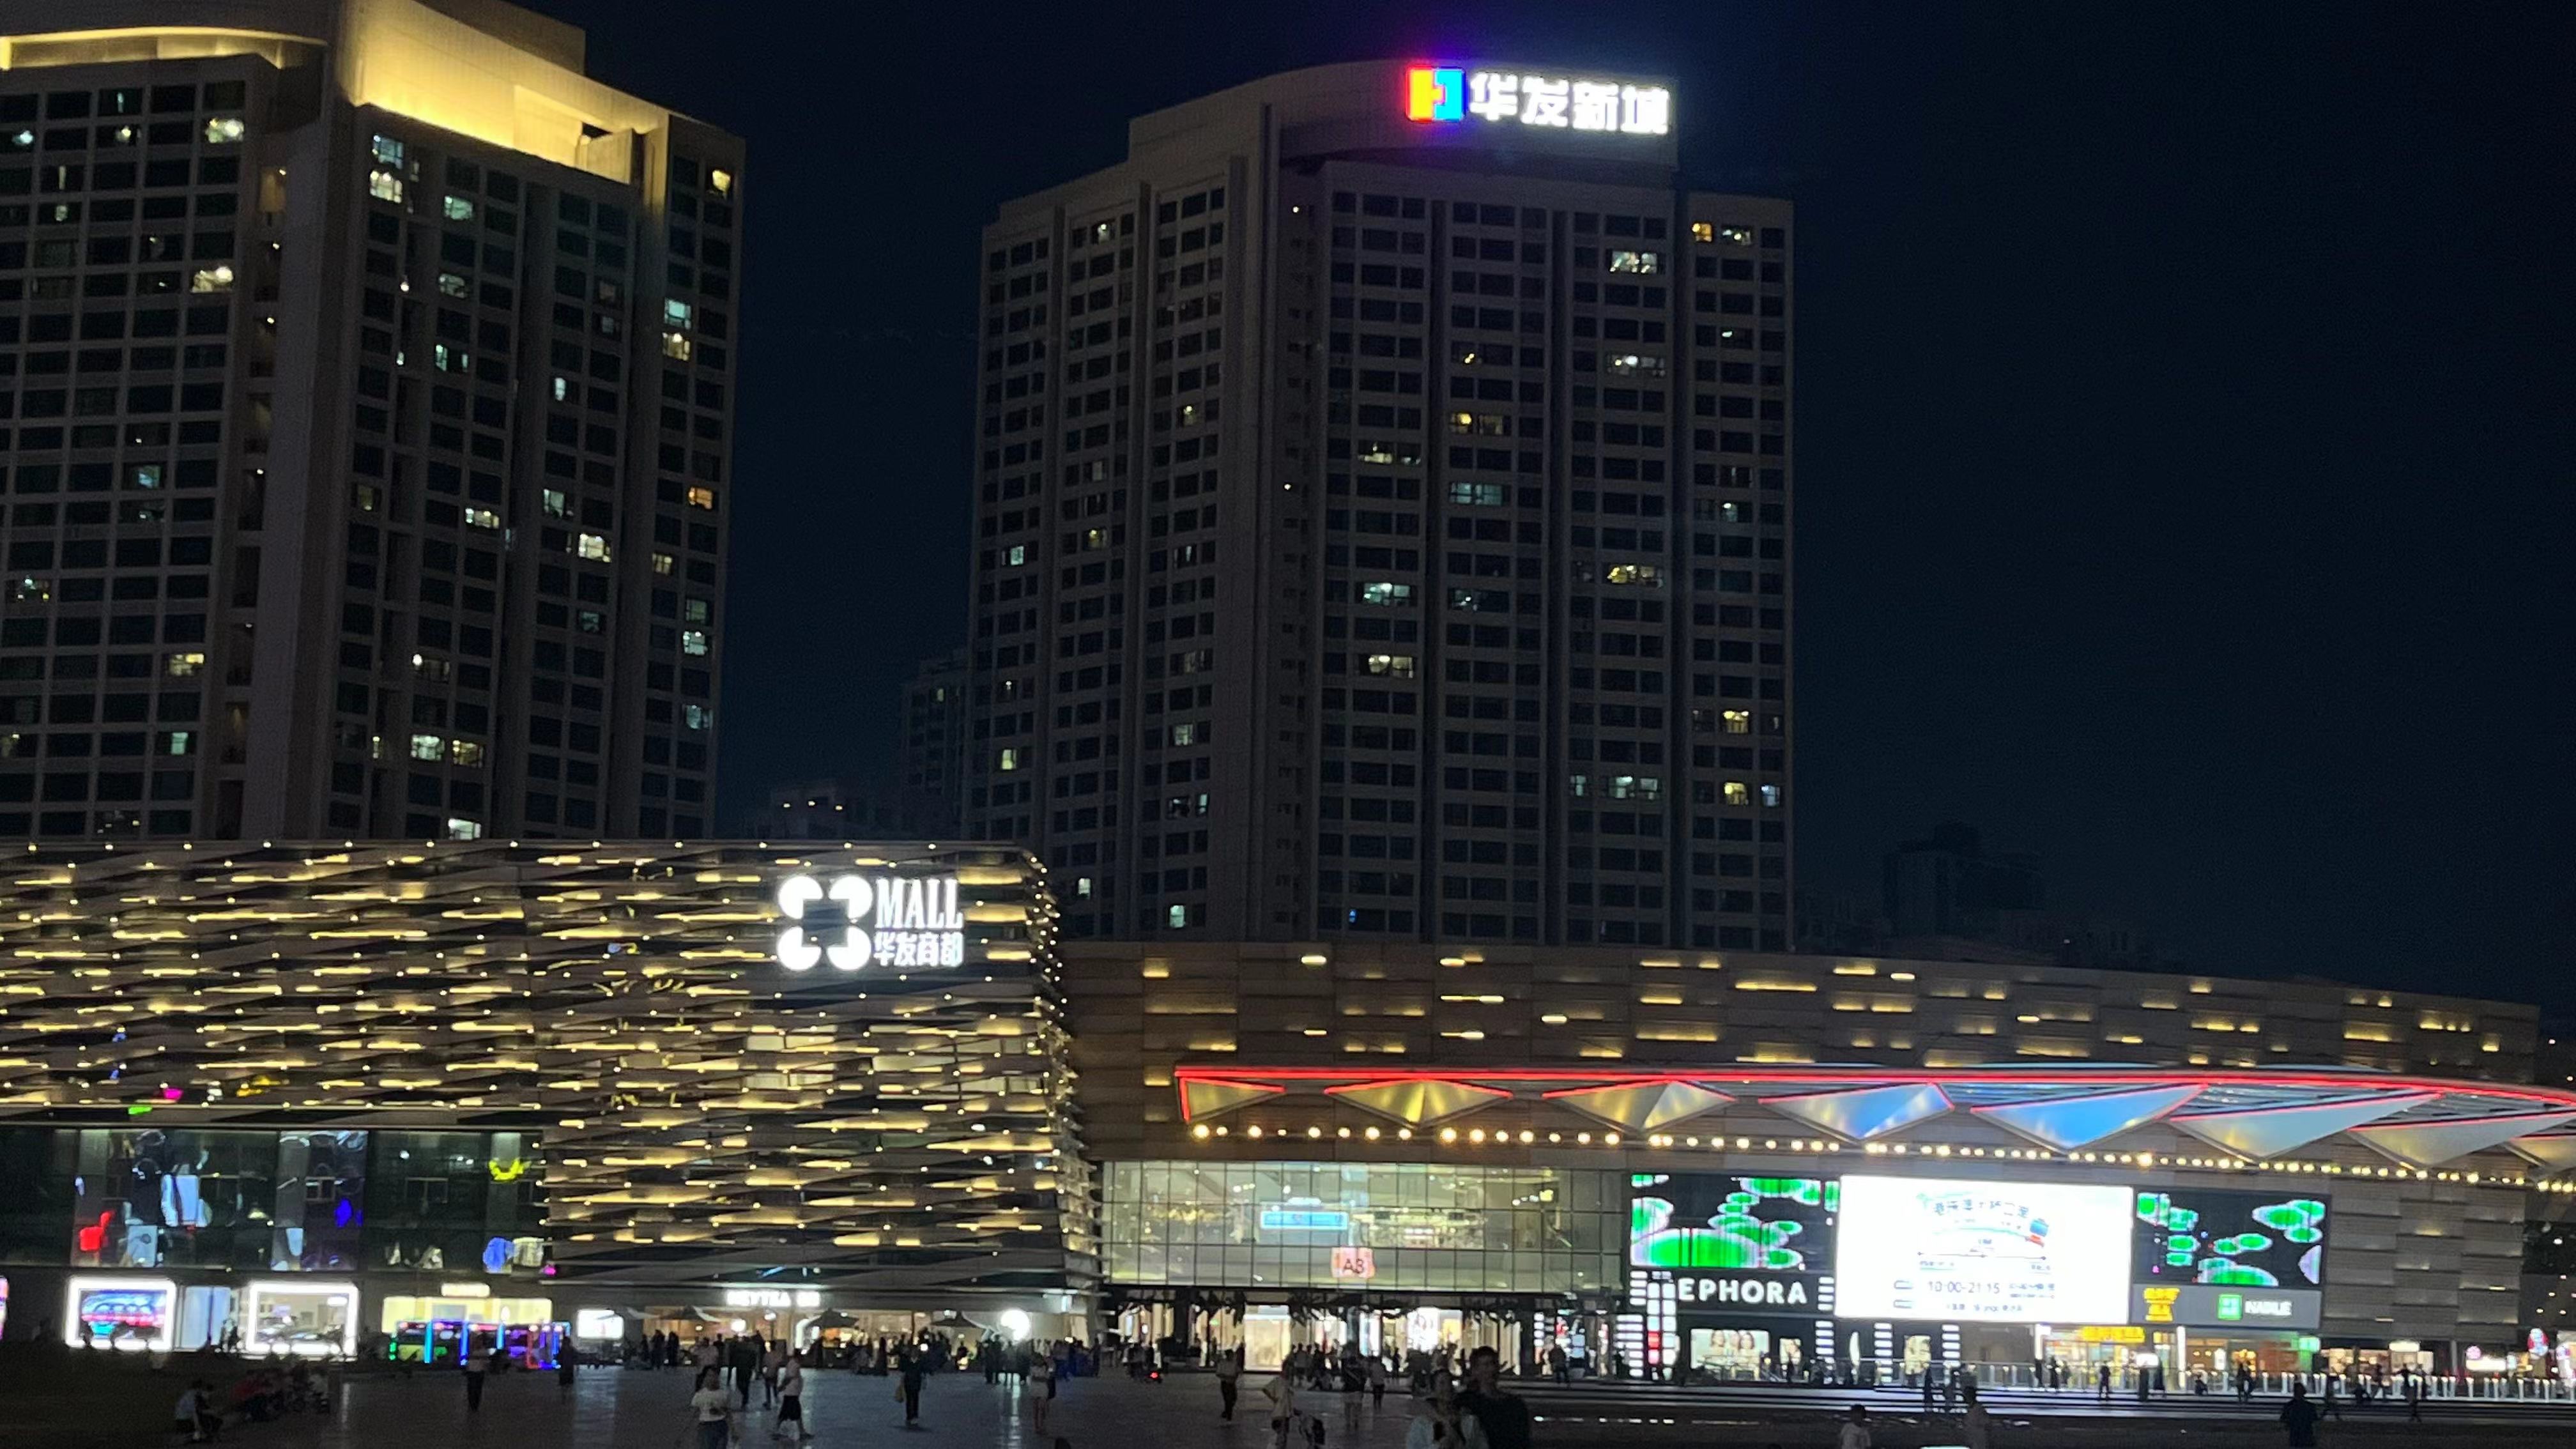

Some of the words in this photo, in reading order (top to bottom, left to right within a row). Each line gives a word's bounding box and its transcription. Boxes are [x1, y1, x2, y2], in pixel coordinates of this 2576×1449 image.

[1470, 73, 1669, 134] 华发新城
[875, 878, 964, 929] MALL
[874, 931, 965, 967] 华发商都
[1343, 1258, 1365, 1275] A3
[1669, 1278, 1807, 1305] EPHORA
